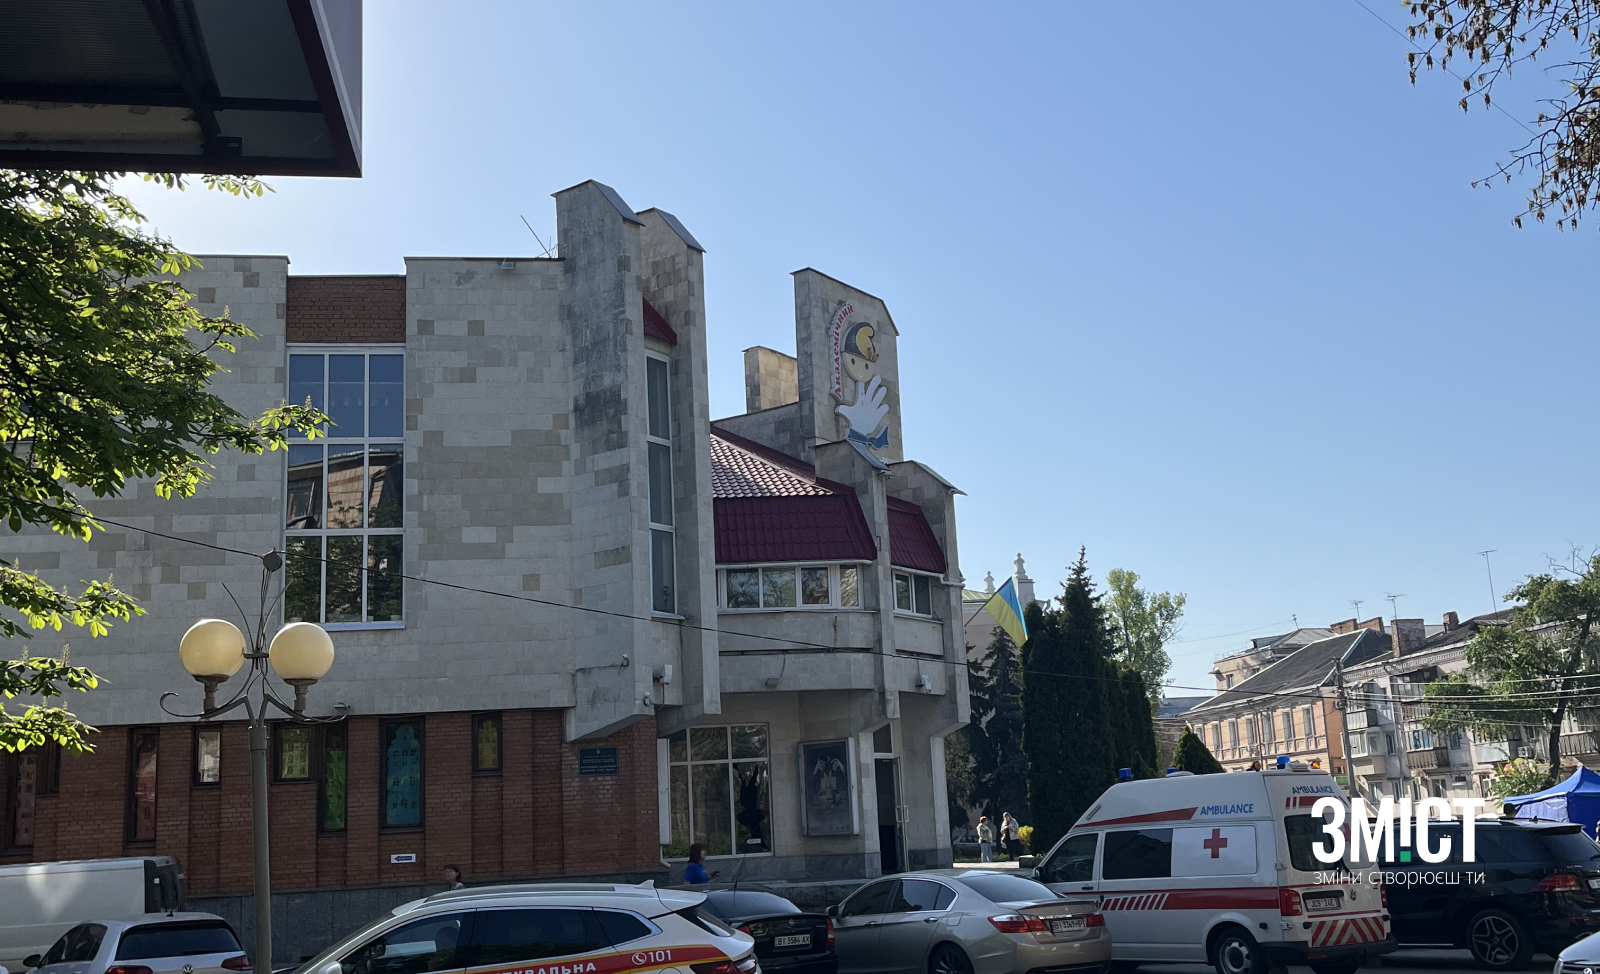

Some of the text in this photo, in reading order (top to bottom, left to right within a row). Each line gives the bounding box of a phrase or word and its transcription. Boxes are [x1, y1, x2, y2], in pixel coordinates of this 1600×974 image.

[1292, 785, 1335, 794] AMBULANCE
[1199, 803, 1254, 816] AMBULANCE
[787, 936, 800, 944] 5584
[648, 949, 672, 963] 101
